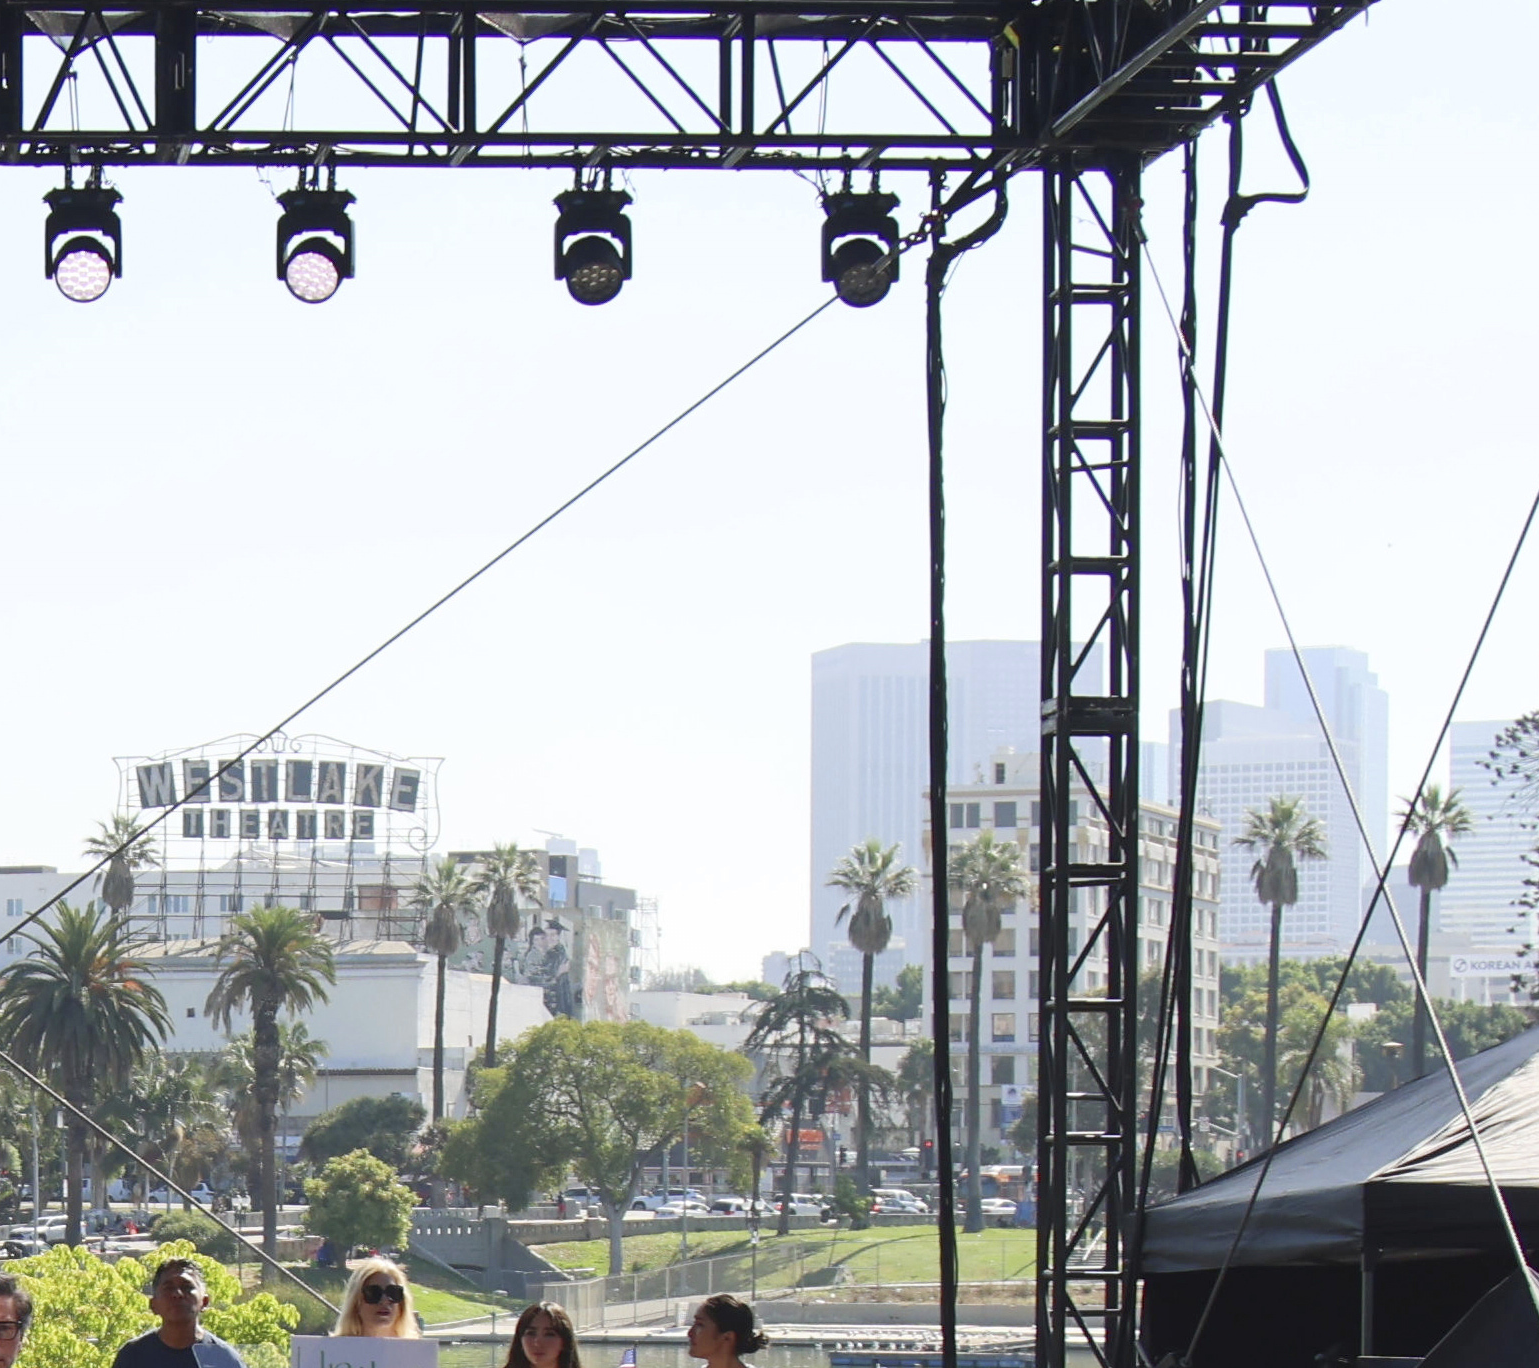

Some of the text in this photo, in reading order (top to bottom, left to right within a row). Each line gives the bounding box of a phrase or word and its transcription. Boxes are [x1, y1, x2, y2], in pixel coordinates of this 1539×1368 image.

[136, 759, 420, 813] WESTLAKE
[183, 808, 374, 840] THEATRE
[1470, 960, 1520, 970] KOREAN
